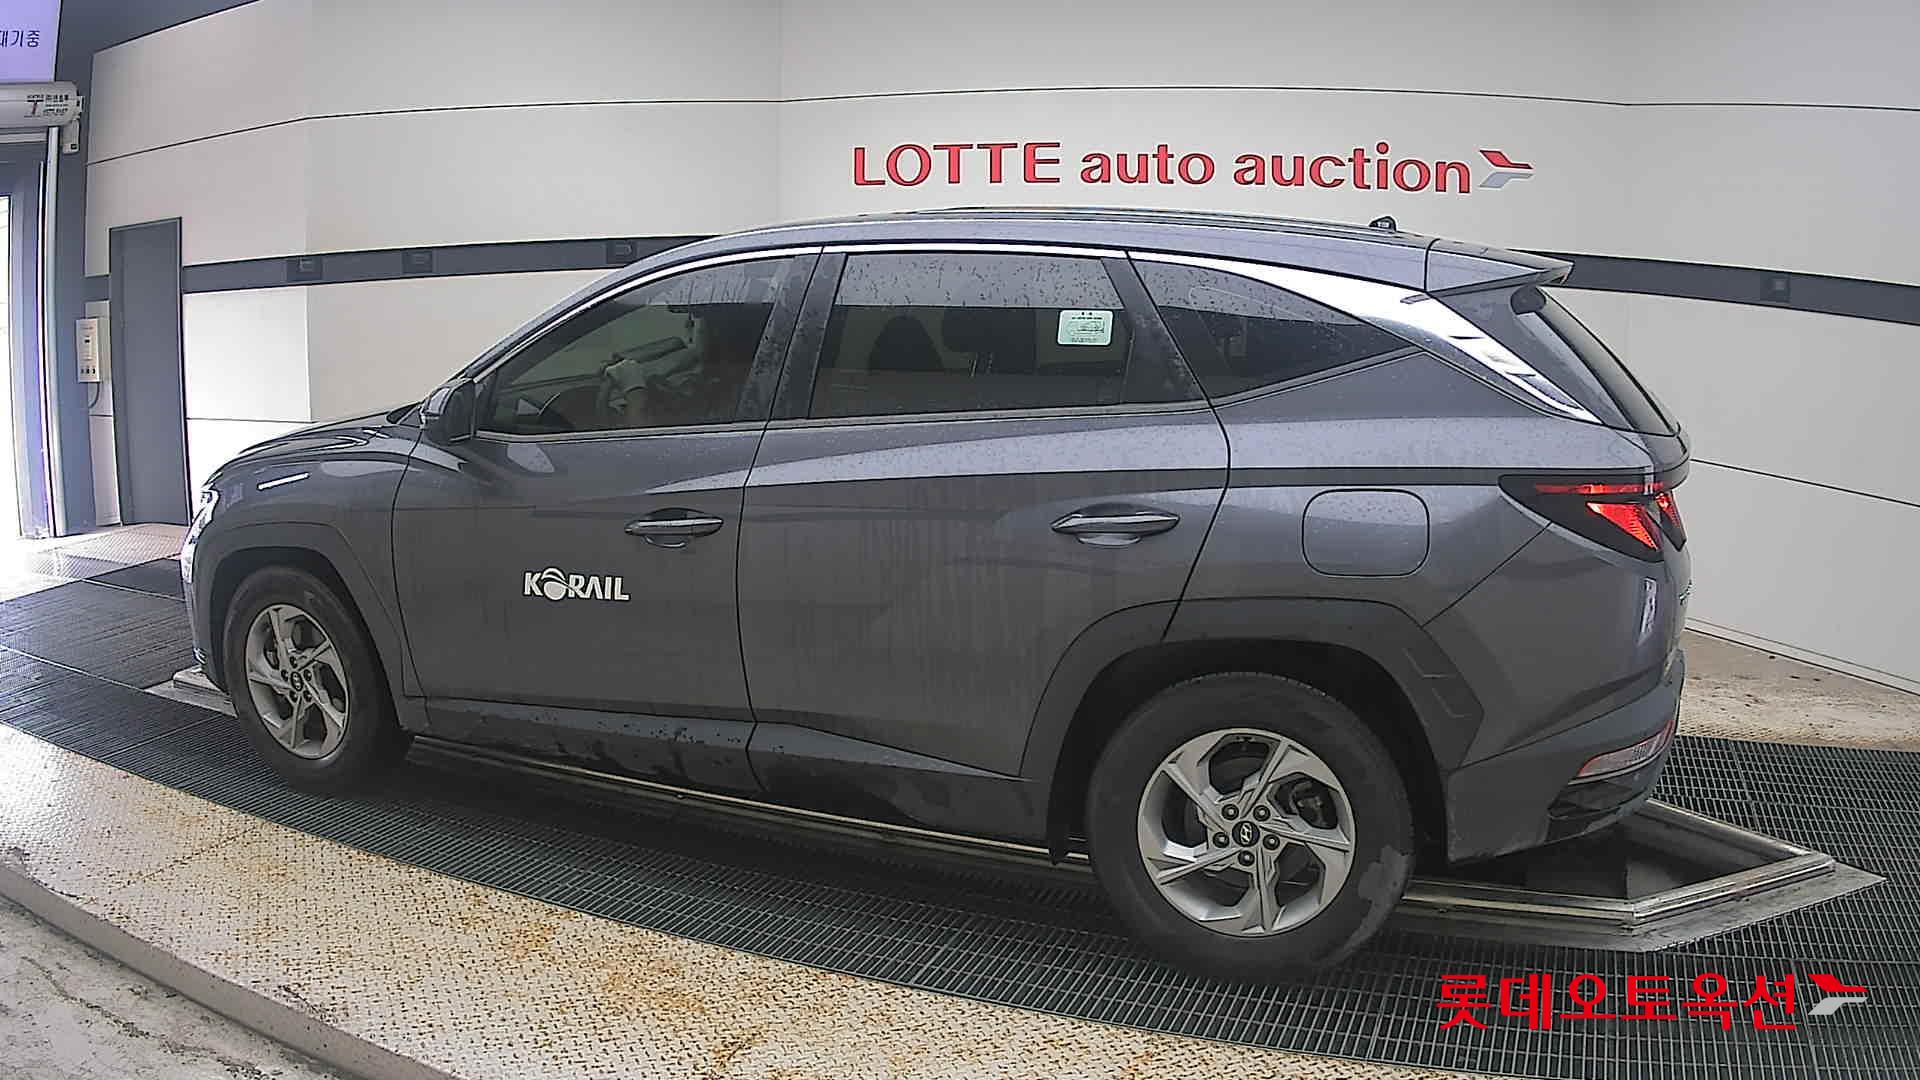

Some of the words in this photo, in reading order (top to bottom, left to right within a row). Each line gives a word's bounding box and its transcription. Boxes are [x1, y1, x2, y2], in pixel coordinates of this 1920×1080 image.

[853, 143, 1060, 187] LOTTE
[1081, 143, 1216, 184] auto
[1234, 142, 1471, 193] auction
[524, 567, 630, 601] KORAIL
